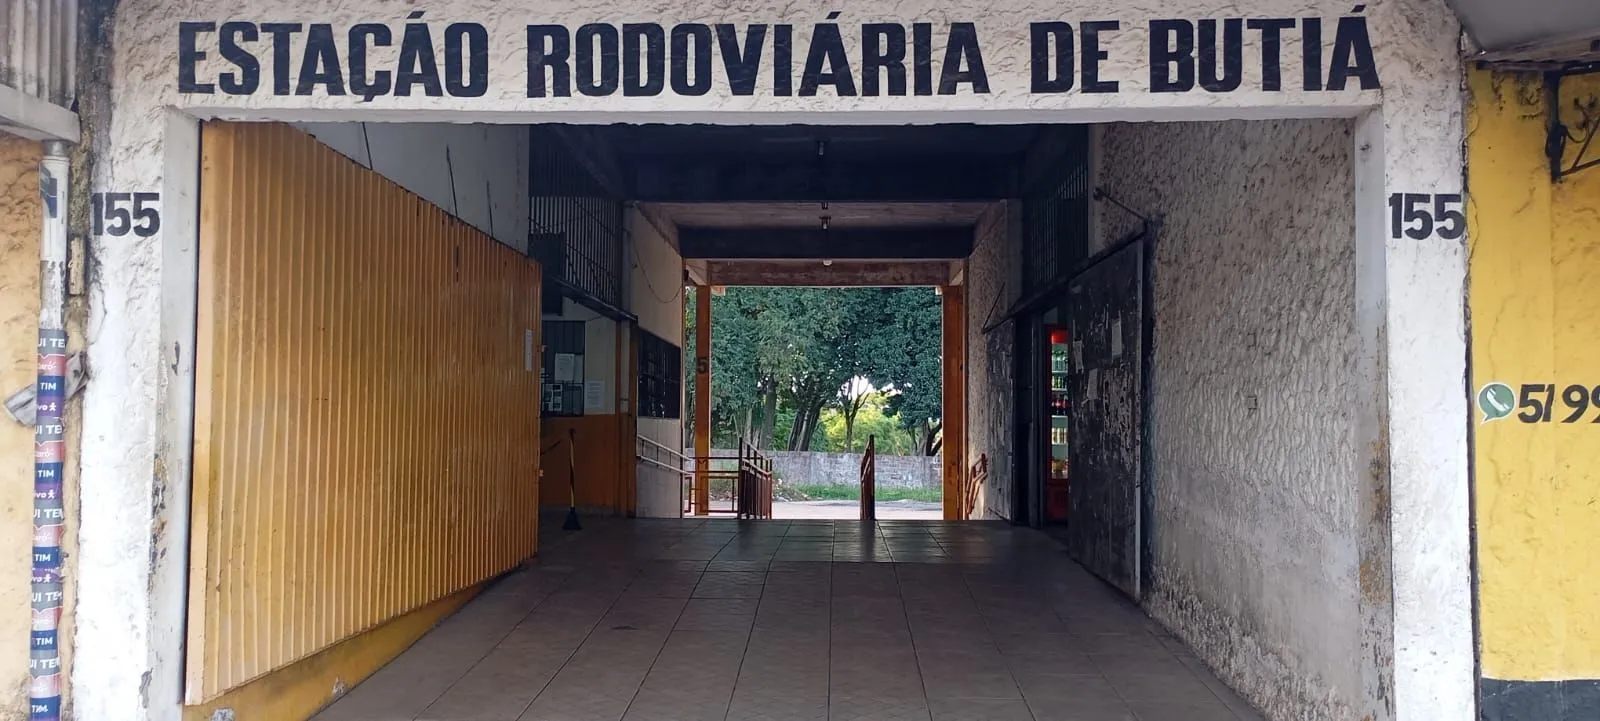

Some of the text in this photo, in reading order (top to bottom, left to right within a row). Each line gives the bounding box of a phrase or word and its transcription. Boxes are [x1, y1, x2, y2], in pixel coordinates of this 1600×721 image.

[178, 4, 1381, 102] ESTAÇÁO RODOVIÁRIA DE BUTIÁ
[91, 192, 160, 237] 155
[1389, 192, 1466, 240] 155
[40, 382, 56, 391] TIM
[1518, 383, 1555, 423] 51
[38, 470, 54, 478] TIM
[35, 554, 51, 562] TIM
[36, 637, 53, 646] TIM
